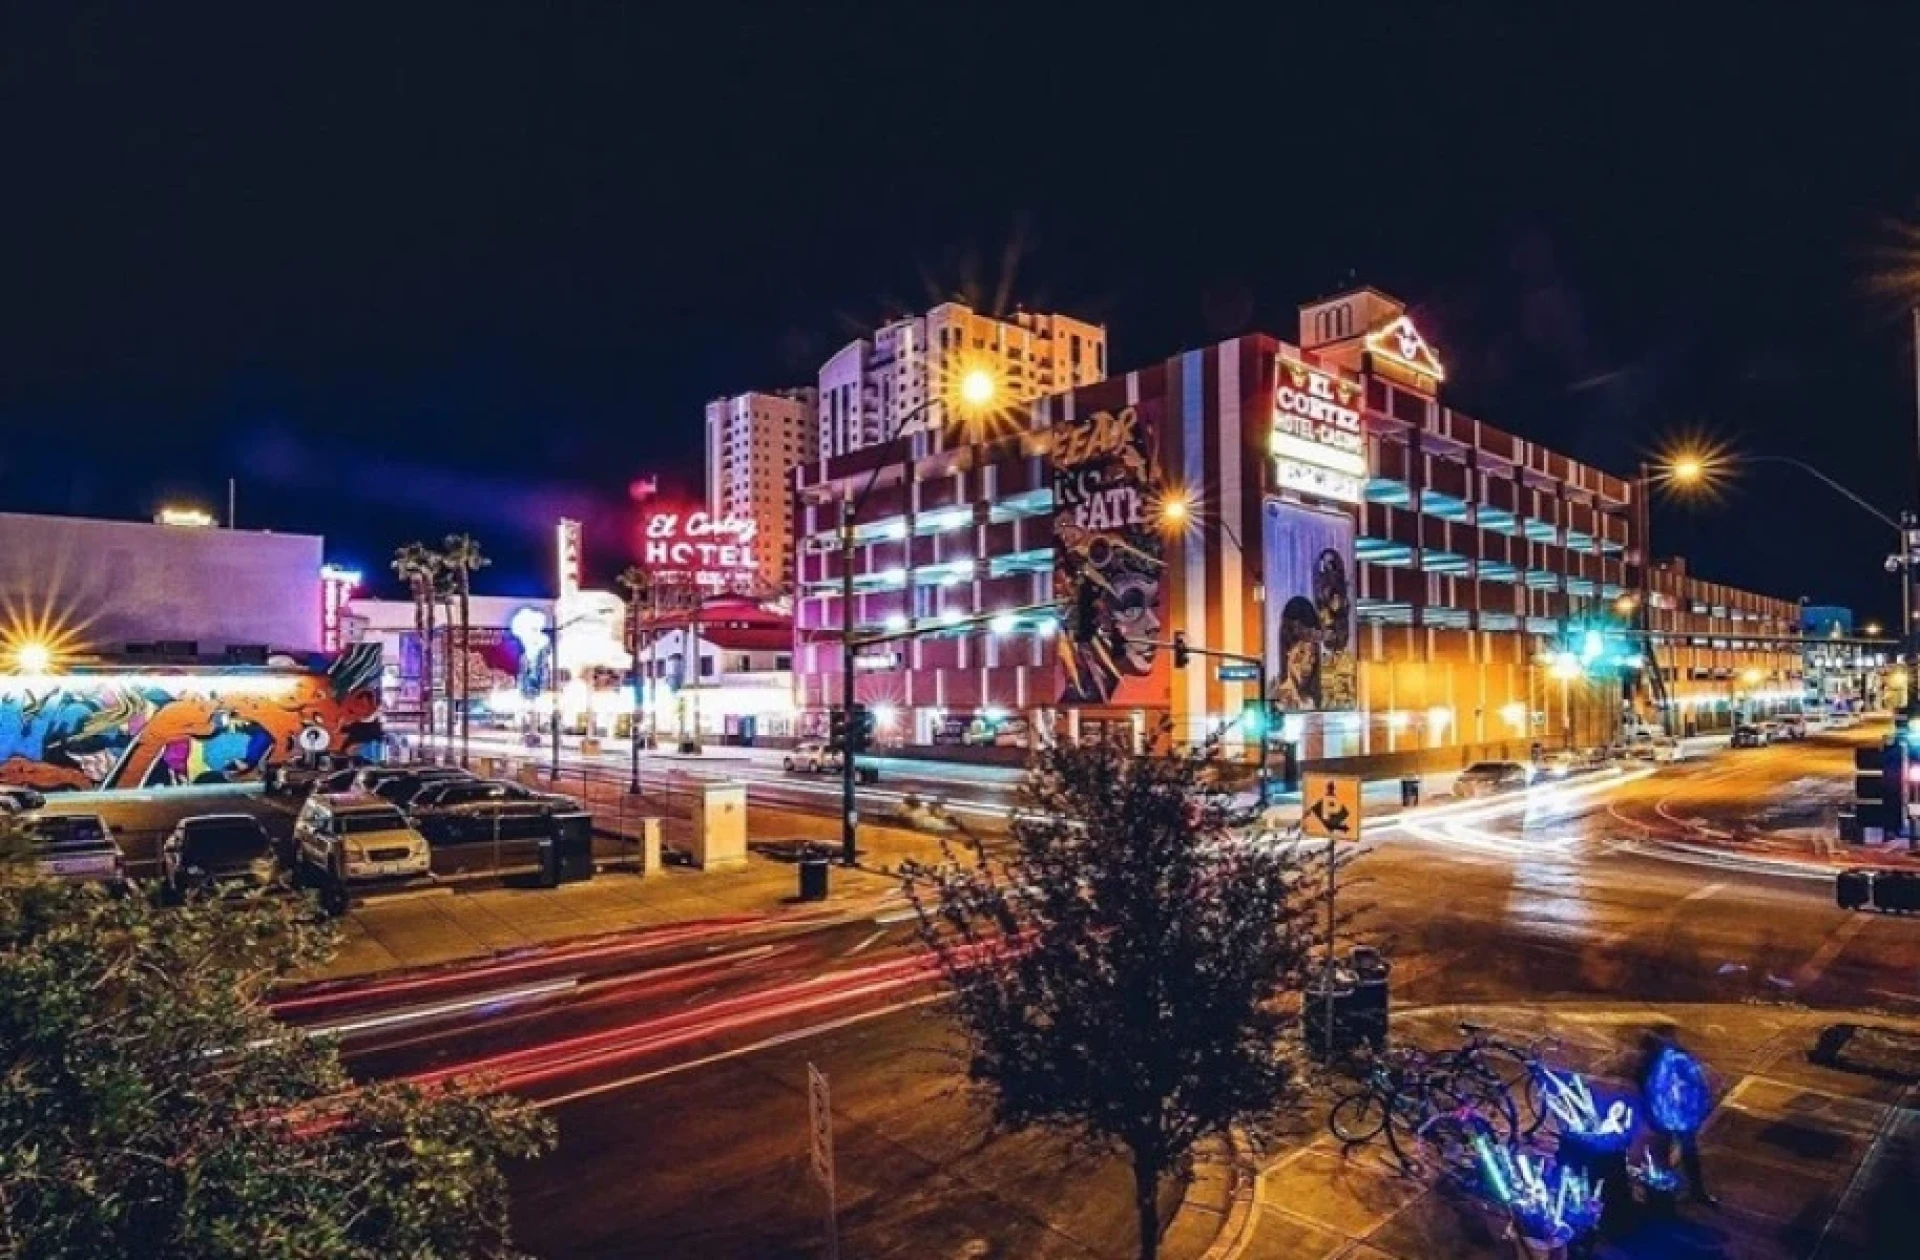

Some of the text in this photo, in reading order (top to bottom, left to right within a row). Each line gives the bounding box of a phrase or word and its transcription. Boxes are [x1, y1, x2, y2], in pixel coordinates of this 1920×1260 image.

[1308, 373, 1335, 400] EL
[1277, 386, 1360, 432] CORTEZ
[645, 513, 679, 538] El
[645, 541, 760, 568] HOTEL
